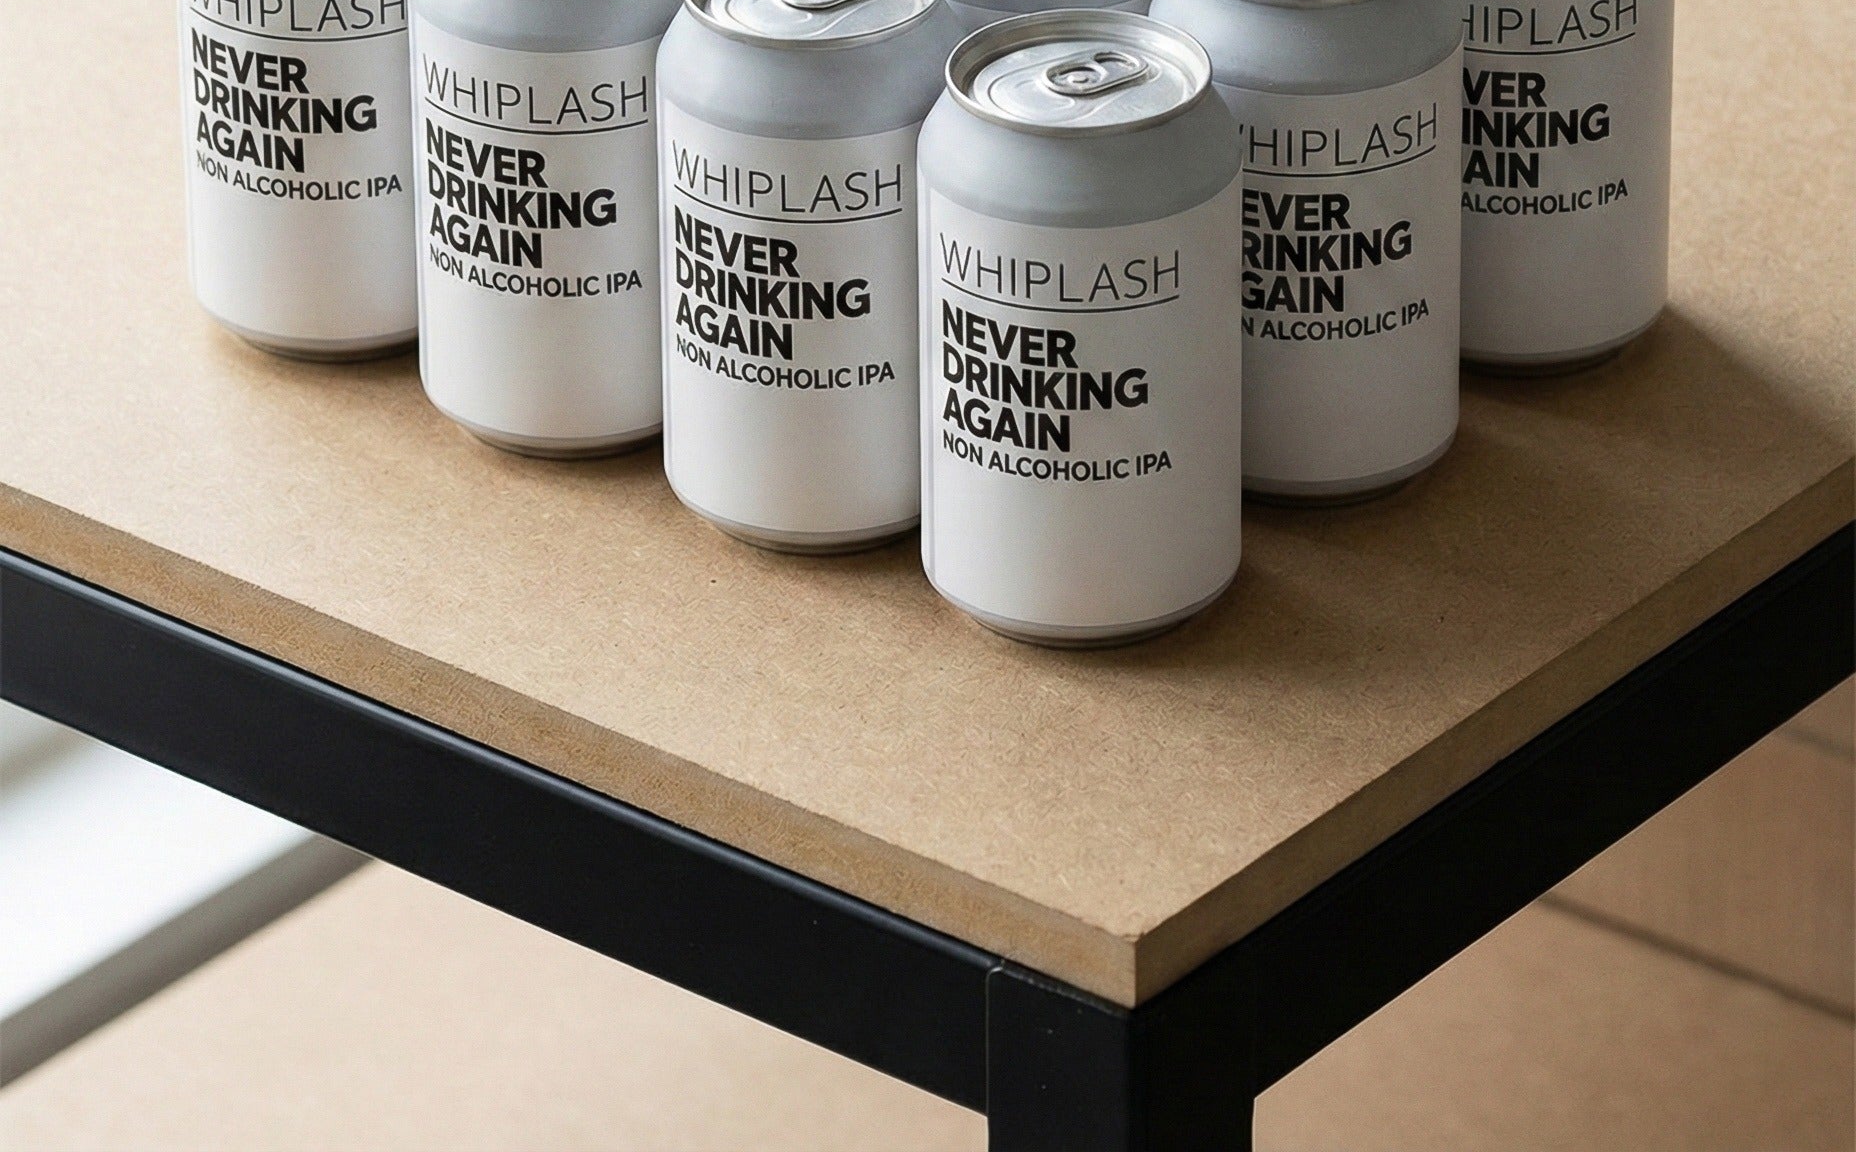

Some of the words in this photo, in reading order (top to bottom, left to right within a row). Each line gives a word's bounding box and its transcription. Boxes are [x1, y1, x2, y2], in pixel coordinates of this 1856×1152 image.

[191, 26, 310, 94] NEVER
[422, 53, 647, 125] WHIPLASH
[1463, 67, 1547, 108] VER
[193, 67, 377, 134] DRINKING
[1462, 103, 1610, 148] INKING
[196, 110, 305, 173] AGAIN
[425, 117, 549, 188] NEVER
[1239, 102, 1437, 167] HIPLASH
[196, 150, 228, 183] NON
[233, 170, 361, 201] ALCOHOLIC
[367, 174, 403, 198] IPA
[428, 158, 617, 230] DRINKING
[672, 140, 901, 214] WHIPLASH
[1461, 190, 1593, 215] ALCOHOLIC
[1598, 178, 1628, 206] IPA
[1463, 150, 1540, 189] AIN
[430, 202, 542, 269] AGAIN
[674, 204, 800, 278] NEVER
[1242, 188, 1351, 232] EVER
[430, 243, 464, 279] NON
[468, 265, 600, 298] ALCOHOLIC
[606, 269, 643, 294] IPA
[940, 232, 1179, 302] WHIPLASH
[1242, 220, 1412, 272] RINKING
[676, 246, 871, 320] DRINKING
[1241, 271, 1344, 314] GAIN
[675, 292, 793, 361] AGAIN
[942, 298, 1079, 368] NEVER
[1260, 310, 1397, 341] ALCOHOLIC
[1402, 298, 1430, 326] IPA
[676, 333, 711, 371] NON
[716, 356, 851, 389] ALCOHOLIC
[858, 361, 895, 386] IPA
[943, 340, 1149, 411] DRINKING
[942, 387, 1070, 453] AGAIN
[943, 428, 983, 466] NON
[988, 450, 1130, 482] ALCOHOLIC
[1136, 450, 1172, 476] IPA
